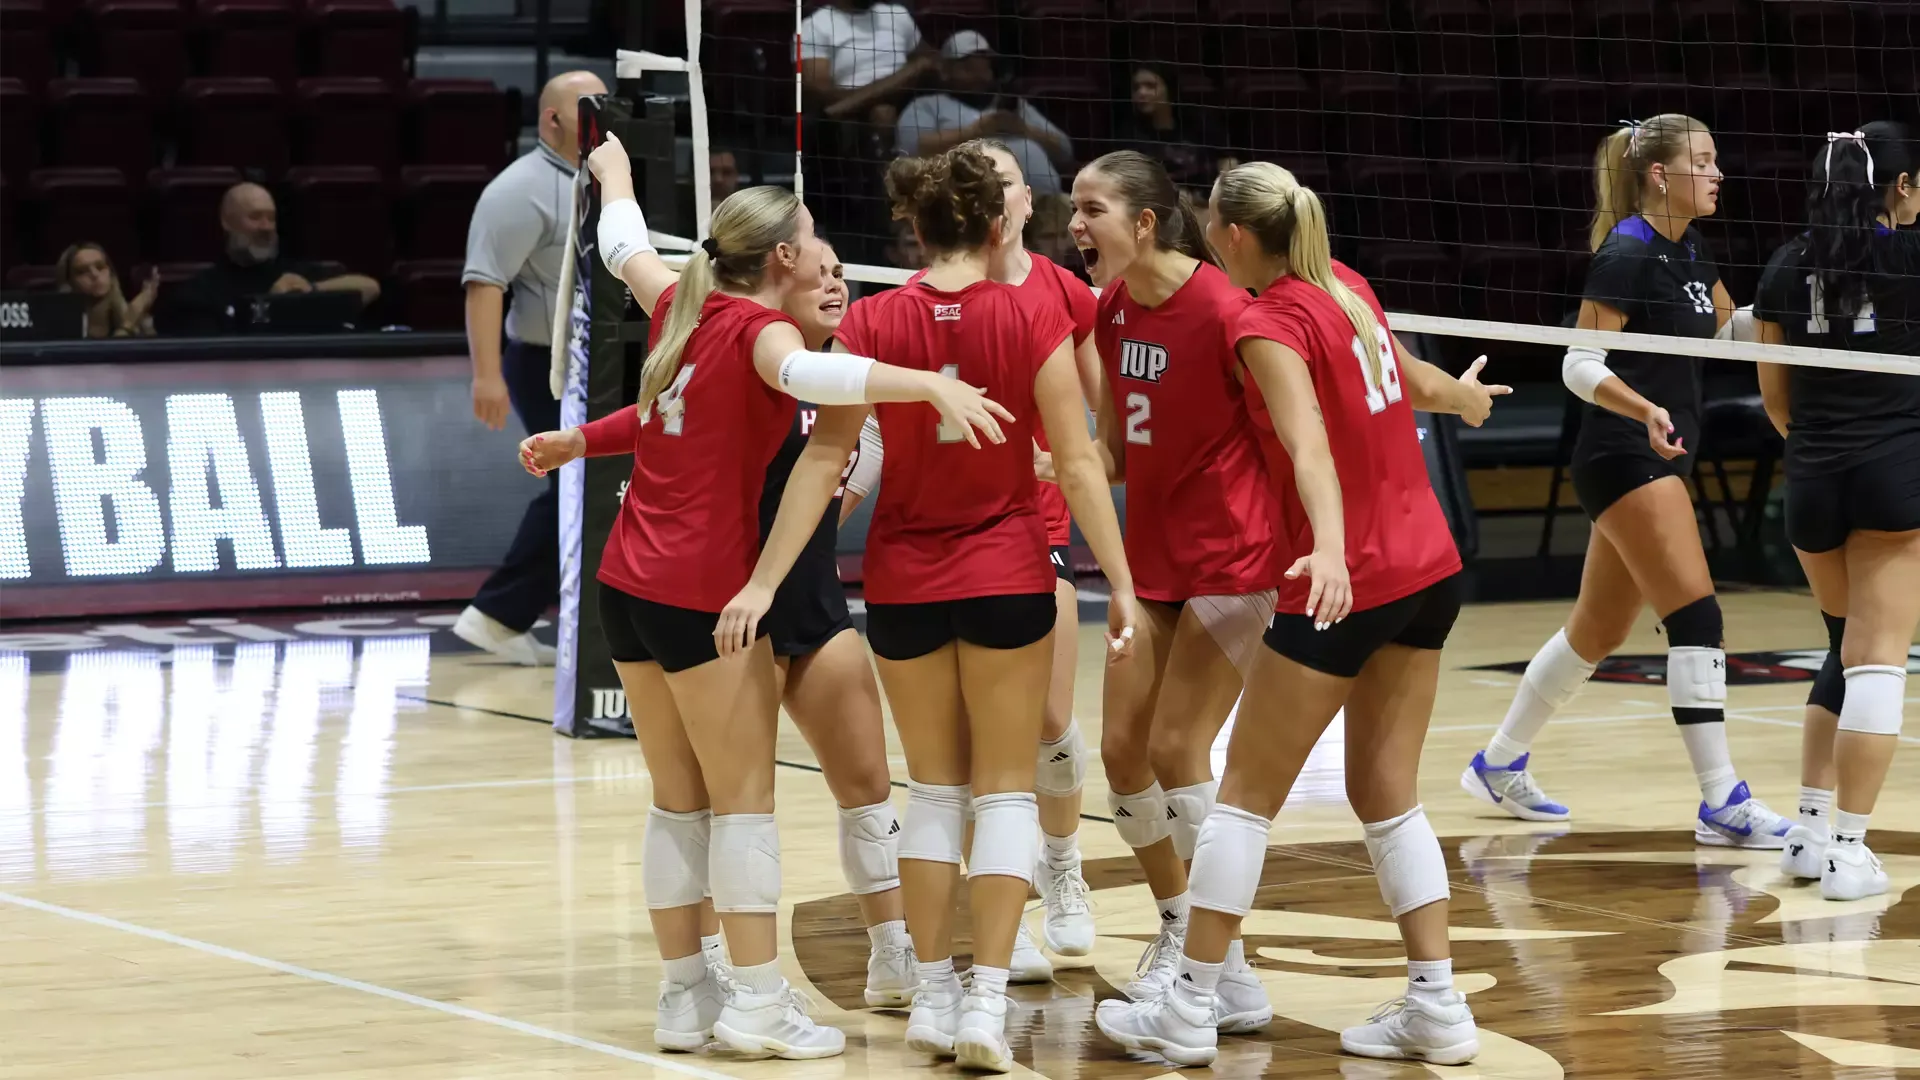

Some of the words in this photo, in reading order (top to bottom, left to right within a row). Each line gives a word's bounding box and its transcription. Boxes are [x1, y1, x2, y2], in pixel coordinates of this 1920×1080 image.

[934, 307, 961, 317] PSAC
[1120, 339, 1168, 383] IUP
[1351, 322, 1402, 415] 18
[1127, 392, 1151, 446] 2
[592, 689, 632, 718] IU
